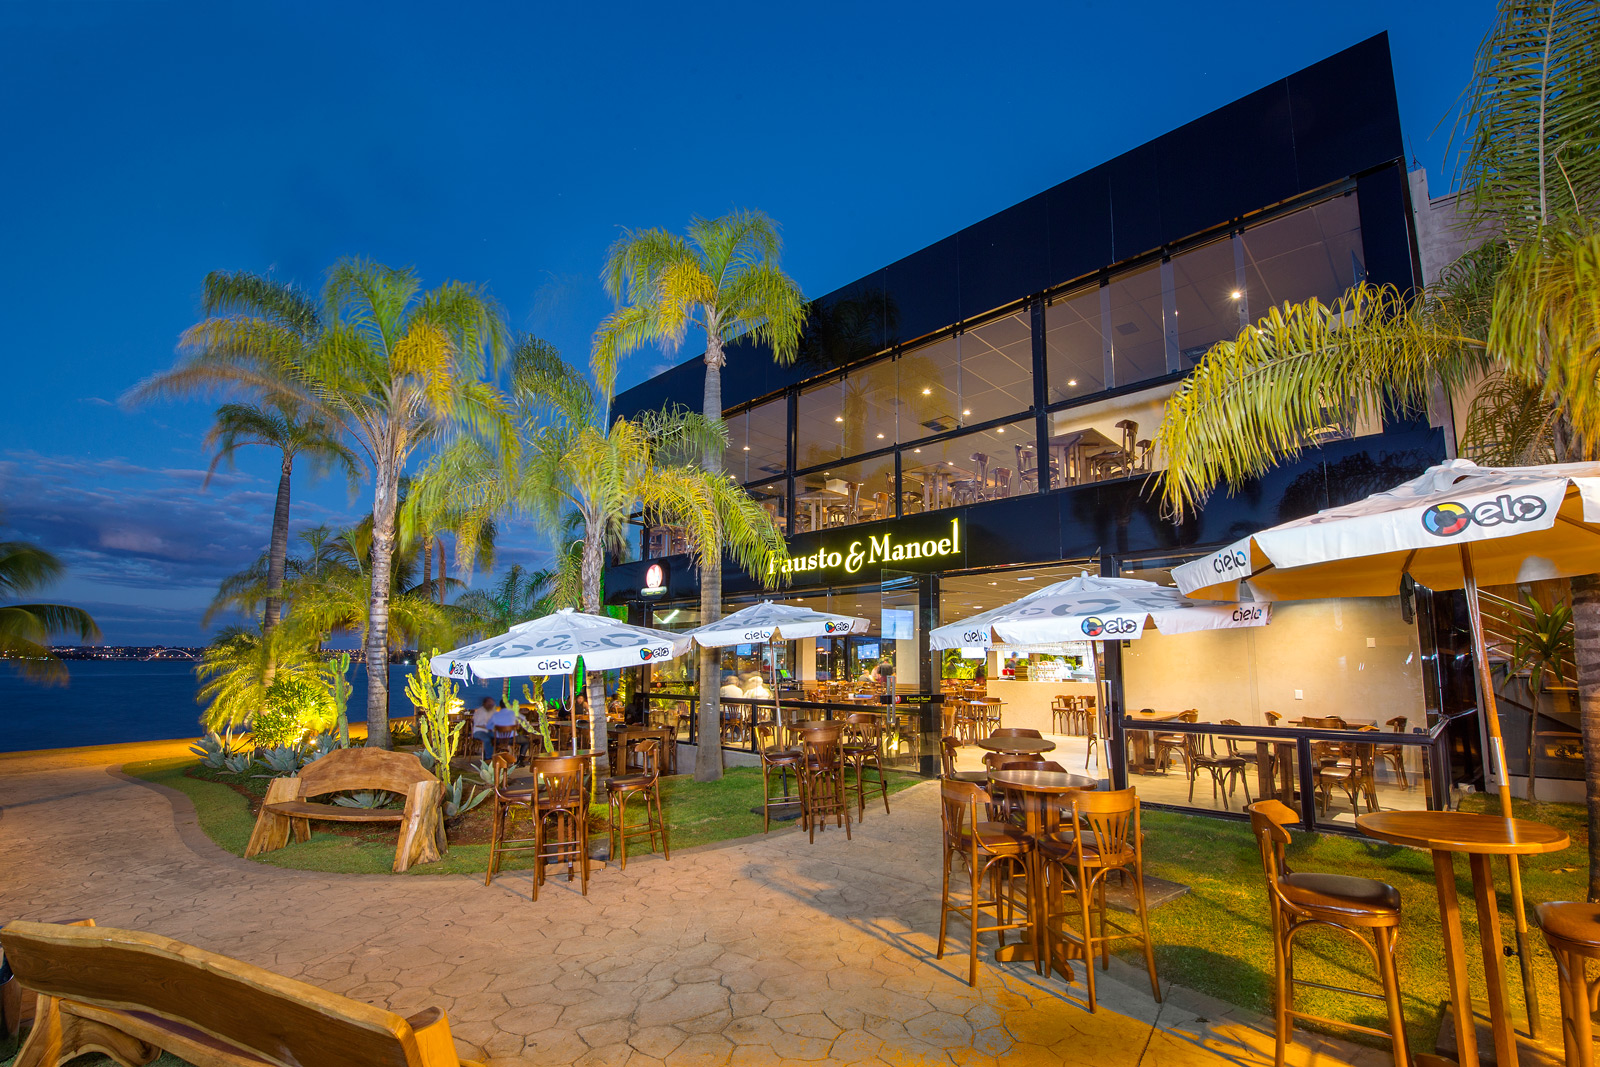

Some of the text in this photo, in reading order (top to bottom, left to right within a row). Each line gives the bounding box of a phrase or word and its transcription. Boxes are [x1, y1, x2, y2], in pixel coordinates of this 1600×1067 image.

[1470, 494, 1547, 527] elo
[845, 541, 866, 573] &
[868, 517, 961, 564] Manoel
[1213, 548, 1247, 574] cielo
[1232, 606, 1261, 622] cielo
[1103, 617, 1137, 634] elo
[744, 630, 771, 640] cielo
[963, 629, 988, 643] cielo
[652, 647, 669, 658] elo
[537, 658, 572, 671] cielo
